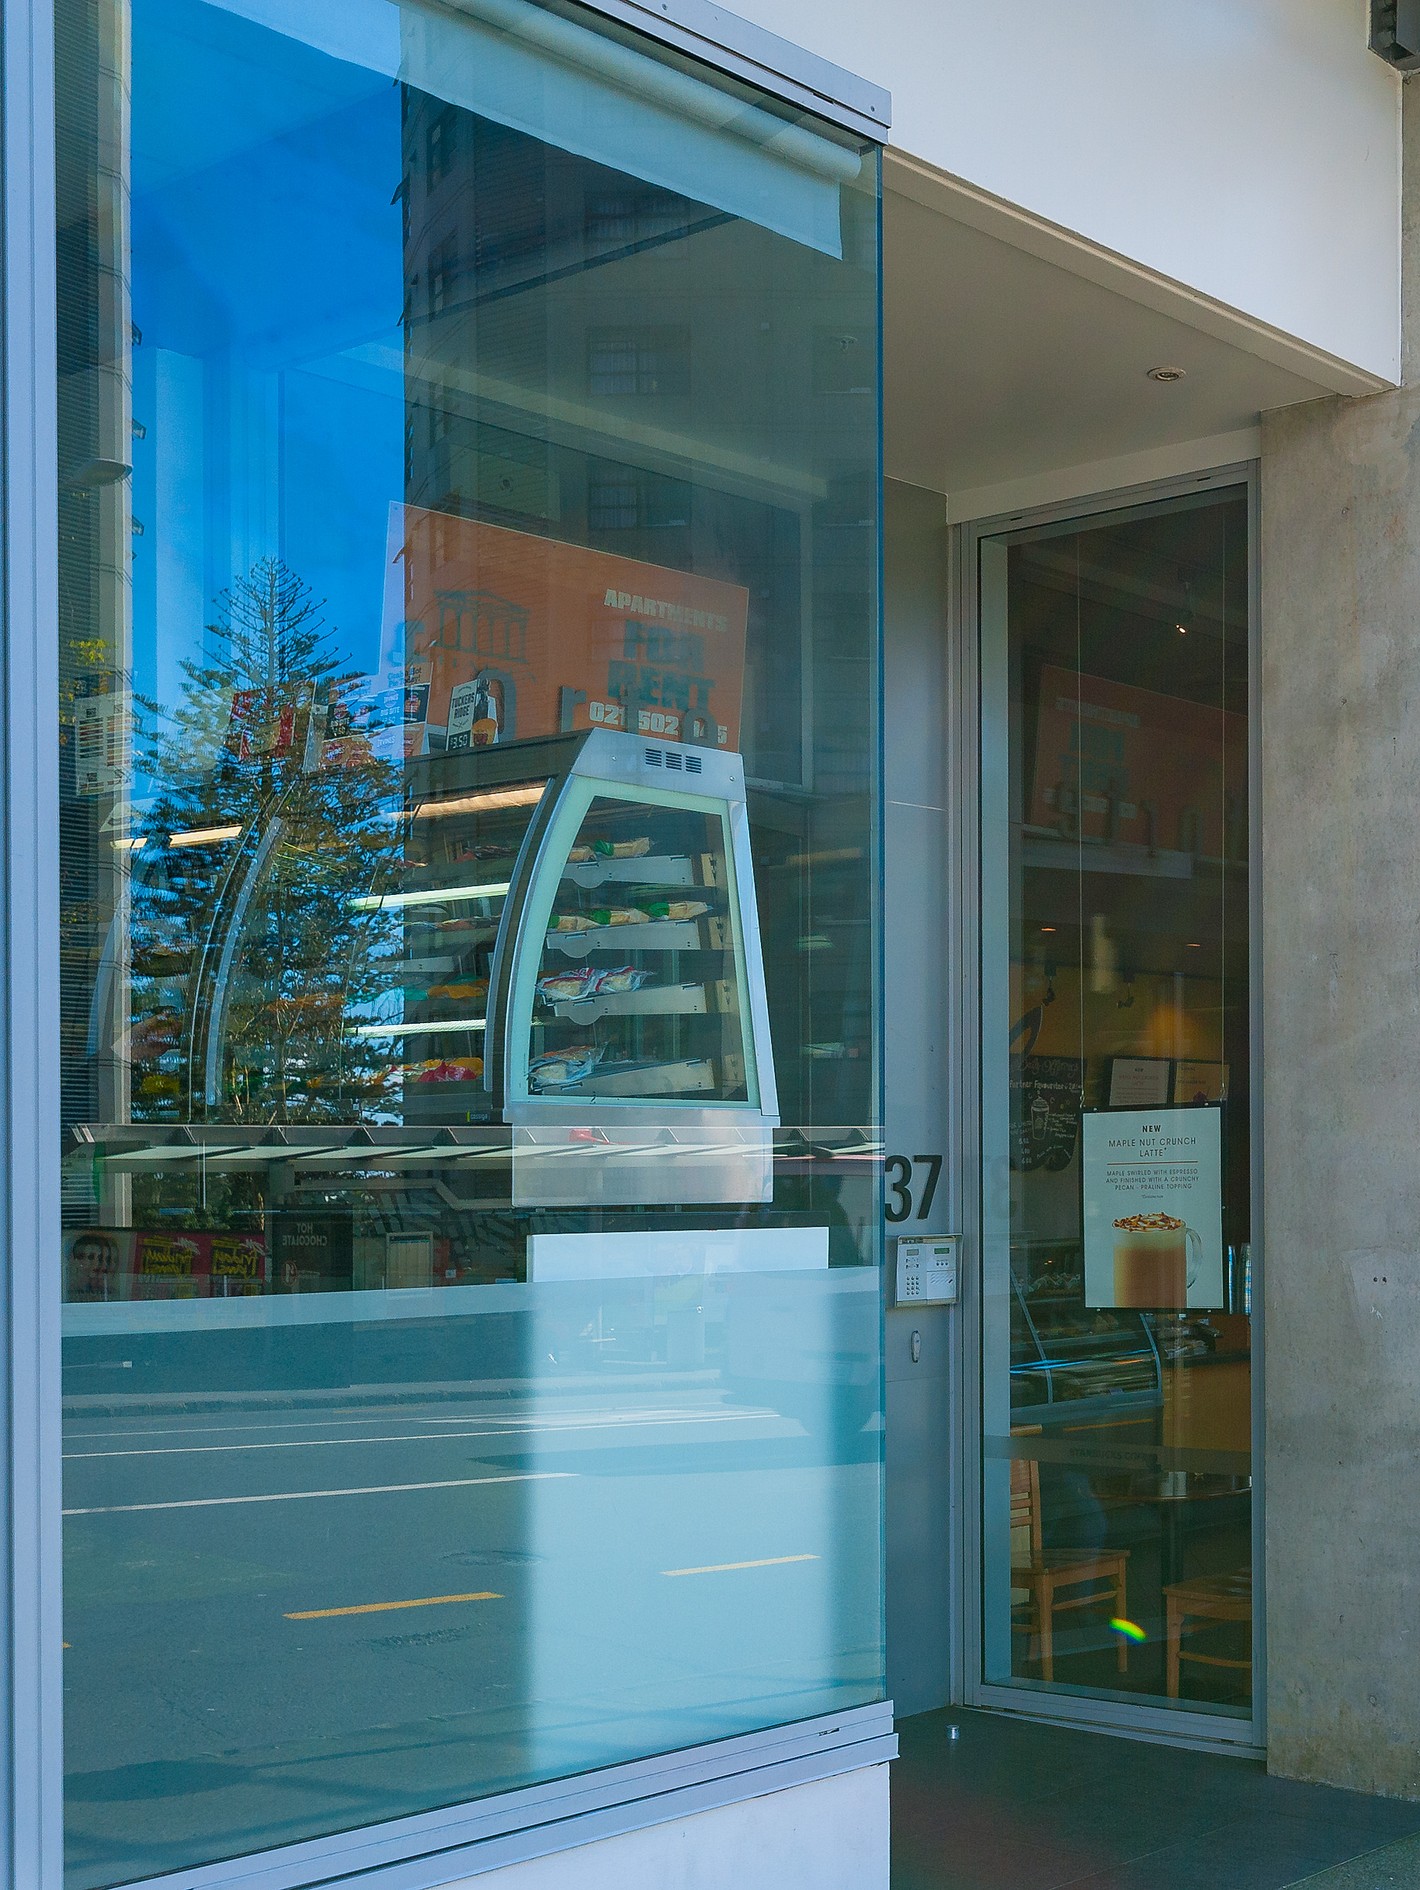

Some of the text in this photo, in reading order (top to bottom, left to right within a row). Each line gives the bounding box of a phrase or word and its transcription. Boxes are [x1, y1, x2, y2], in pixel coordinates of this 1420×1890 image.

[603, 588, 728, 632] APARTMENTS
[624, 619, 706, 672] FOR
[608, 659, 717, 711] RENT
[638, 709, 680, 736] 502
[1108, 1137, 1196, 1147] MAPLE NUT CRUNCH
[1142, 1125, 1161, 1133] NEW
[884, 1154, 943, 1223] 37
